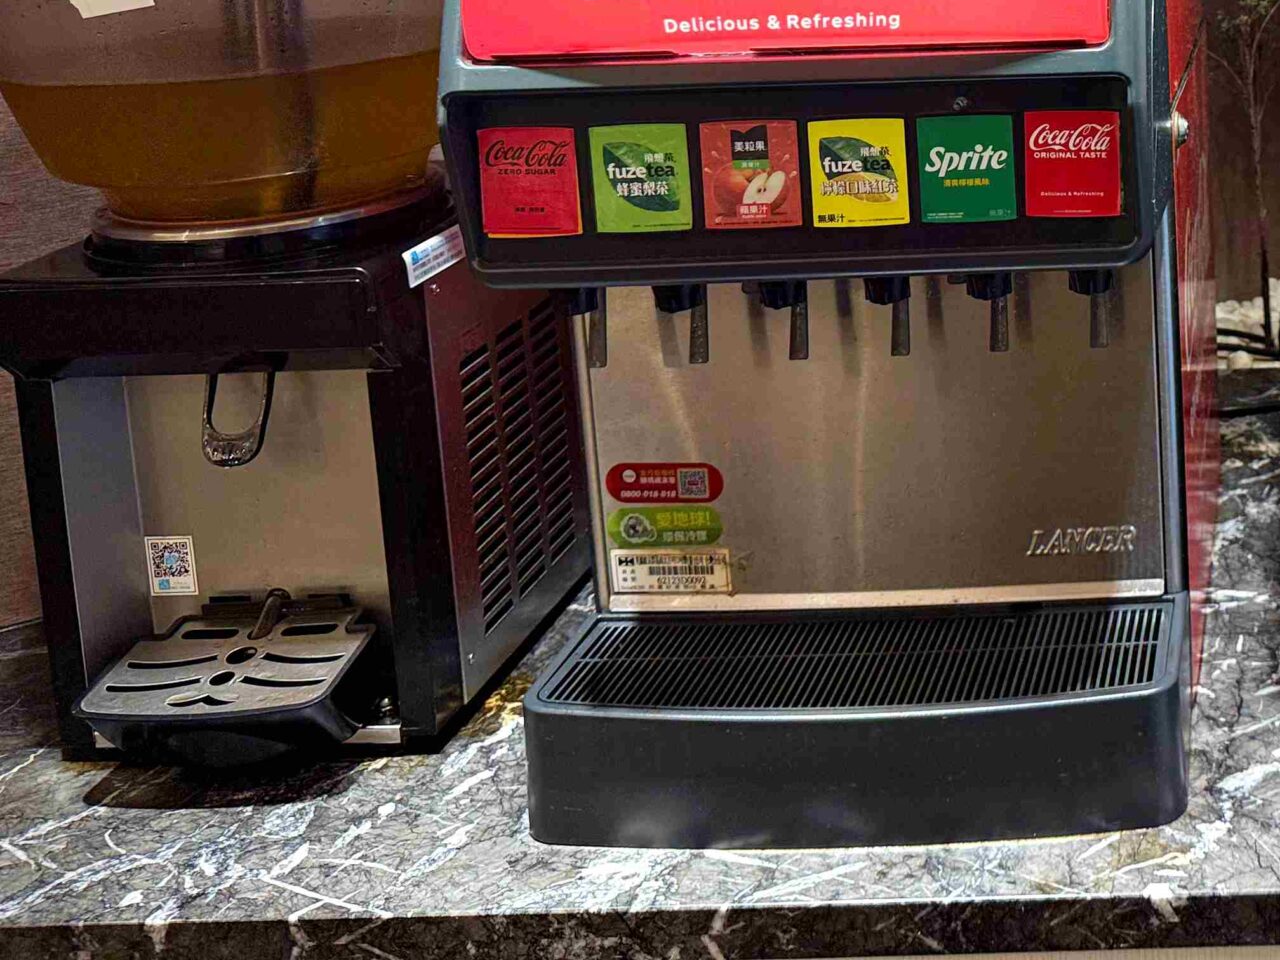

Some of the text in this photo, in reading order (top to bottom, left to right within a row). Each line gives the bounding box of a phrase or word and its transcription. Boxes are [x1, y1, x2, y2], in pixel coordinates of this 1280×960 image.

[663, 10, 901, 33] Delicious & Refreshing
[1029, 123, 1116, 151] Coca-Cola
[485, 140, 571, 168] Coca-Cola
[925, 144, 1008, 177] Sprite
[818, 213, 845, 223] 無果汁
[1026, 525, 1137, 555] LANCER
